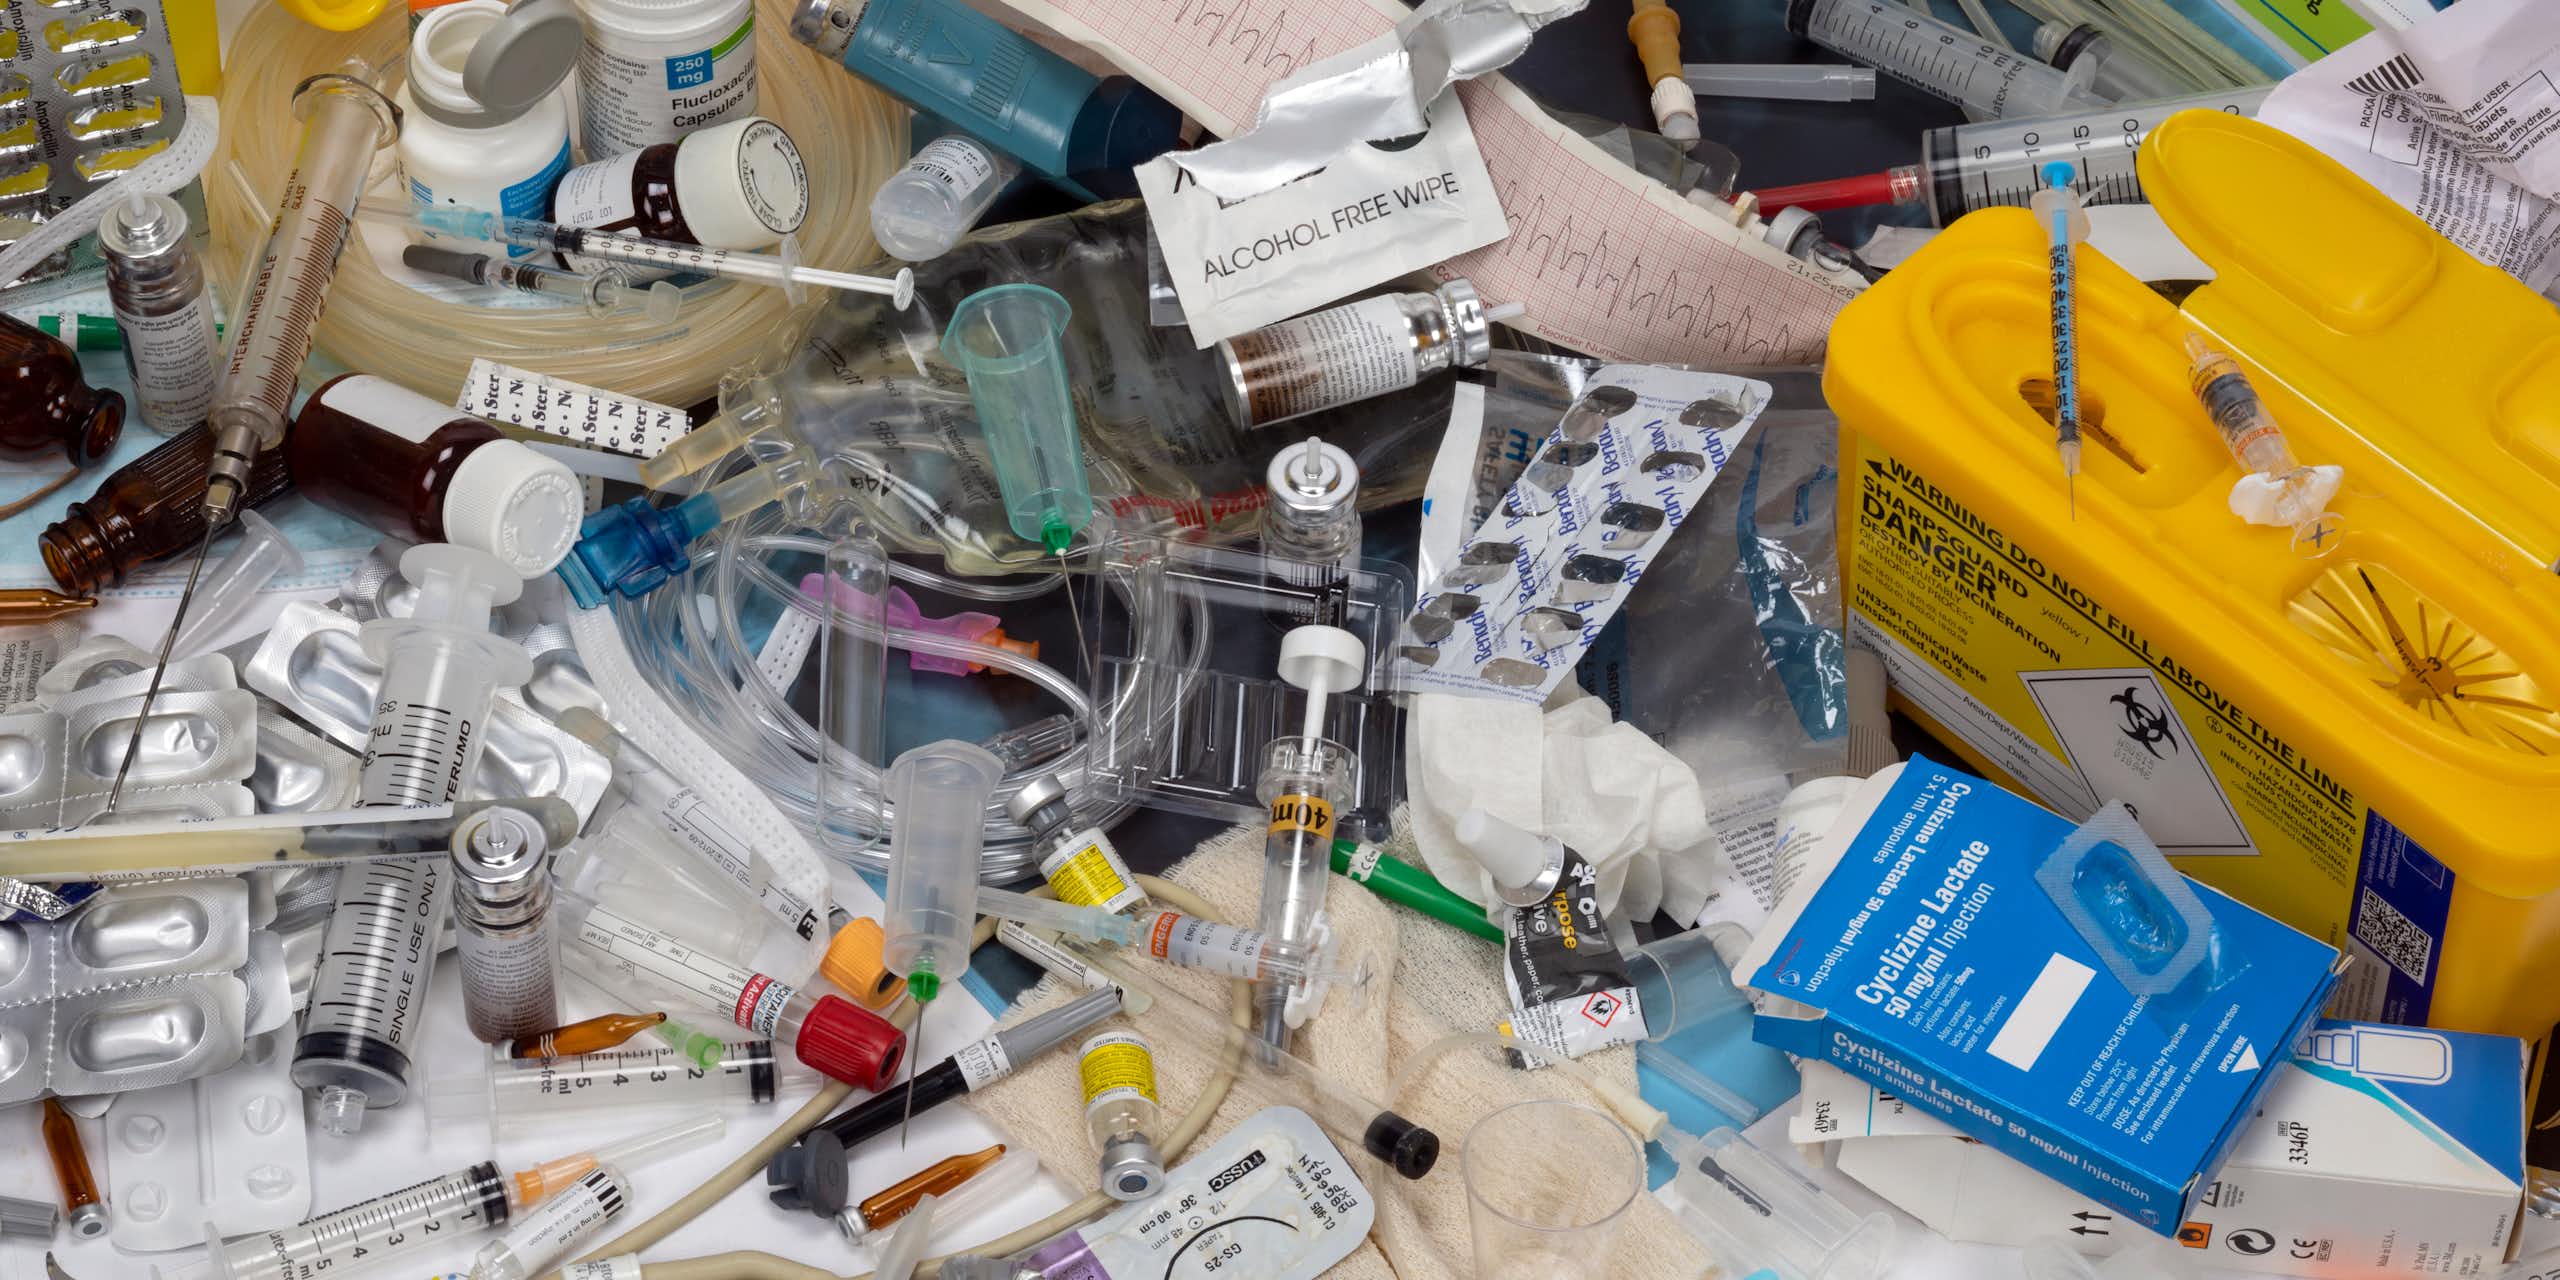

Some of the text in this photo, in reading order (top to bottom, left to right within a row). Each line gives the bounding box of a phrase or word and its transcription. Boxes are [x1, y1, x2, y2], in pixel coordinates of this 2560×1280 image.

[8, 0, 34, 61] Amoxicillin
[1904, 19, 1919, 31] 6
[1940, 35, 1954, 45] 8
[674, 56, 704, 72] 250
[1975, 45, 2011, 67] 10 ml
[677, 71, 704, 84] mg
[673, 88, 744, 128] Capsules
[2463, 82, 2511, 119] THE USER
[34, 100, 59, 159] Amoxicillin
[2023, 131, 2041, 158] 10
[2074, 124, 2091, 152] 15
[2123, 117, 2141, 148] 20
[2407, 106, 2552, 150] Active dihydrate
[2479, 117, 2517, 145] Tablets
[1974, 145, 1991, 160] 5
[2509, 134, 2546, 163] have just
[1203, 171, 1460, 283] ALCOHOL FREE WIPE
[2484, 222, 2498, 246] yours
[1786, 259, 1857, 300] 21:25:28
[230, 255, 277, 375] INTERCHANGEABLE
[1536, 324, 1584, 347] Reorder
[1862, 475, 2029, 598] SHARPSGUARD
[1862, 490, 1997, 602] DANGER
[1877, 541, 1912, 567] OTHER
[1860, 515, 1929, 567] DESTROY
[1931, 565, 1951, 583] BY
[1954, 580, 2063, 664] INCINERATION
[1927, 587, 1975, 625] PROCESS
[1856, 583, 1988, 684] UN3291 Clinical Waste
[1890, 457, 2355, 810] WARNING DO NOT FILL ABOVE THE LINE
[2040, 606, 2083, 638] yellow
[2, 643, 17, 684] Capsules
[378, 700, 397, 715] 35
[370, 724, 393, 740] mL
[444, 719, 472, 803] TERUMO
[2219, 749, 2276, 798] INFECTIOUS
[2276, 792, 2319, 832] CLINICAL
[2259, 769, 2318, 817] HAZARDOUS
[1872, 774, 1949, 865] 5 x 1ml ampoules
[1914, 782, 1973, 844] Cyclizine
[2280, 808, 2327, 847] INCLUDING
[1876, 844, 1927, 897] Lactate
[778, 902, 800, 924] 5 ml
[1533, 903, 1547, 933] ive
[1552, 888, 1577, 950] rpose
[1865, 896, 1885, 913] 50
[1840, 909, 1871, 946] mg/ml
[1855, 839, 1991, 1005] Cyclizine Lactate
[389, 863, 438, 1046] SINGLE USE ONLY
[1884, 881, 1996, 1019] 50 mg/ml Injection
[1804, 944, 1850, 993] Injection
[2067, 1023, 2128, 1108] KEEP OUT OF REACH OF
[2136, 1022, 2191, 1097] directed Physician
[2217, 1033, 2249, 1074] OPEN HERE
[558, 1079, 571, 1095] ml
[576, 1076, 591, 1089] 5
[612, 1073, 629, 1087] 4
[650, 1070, 667, 1083] 3
[688, 1066, 704, 1081] 2
[724, 1064, 742, 1077] 1
[1831, 1047, 1954, 1115] 5 x 1ml ampoules
[2140, 1003, 2241, 1145] For intramuscular intravenous injection
[2083, 1076, 2116, 1116] Store below
[2095, 1081, 2128, 1122] Protect from
[2124, 1064, 2179, 1137] See enclosed leaflet
[1814, 1100, 1830, 1133] 3346P
[1833, 1032, 2151, 1203] Cyclizine Lactate 50 mg/ml Injection
[2288, 1121, 2310, 1166] 3346P
[1336, 1184, 1359, 1208] EXP
[424, 1220, 441, 1234] 2
[461, 1209, 477, 1221] 1
[1139, 1221, 1158, 1235] cm
[1157, 1210, 1173, 1225] 90
[1309, 1201, 1336, 1231] CL-905
[352, 1246, 368, 1259] 4
[388, 1233, 405, 1245] 3
[1151, 1227, 1186, 1251] 48 mm
[2289, 1237, 2318, 1260] CE
[316, 1258, 332, 1270] 5
[1204, 1242, 1242, 1273] GS-25
